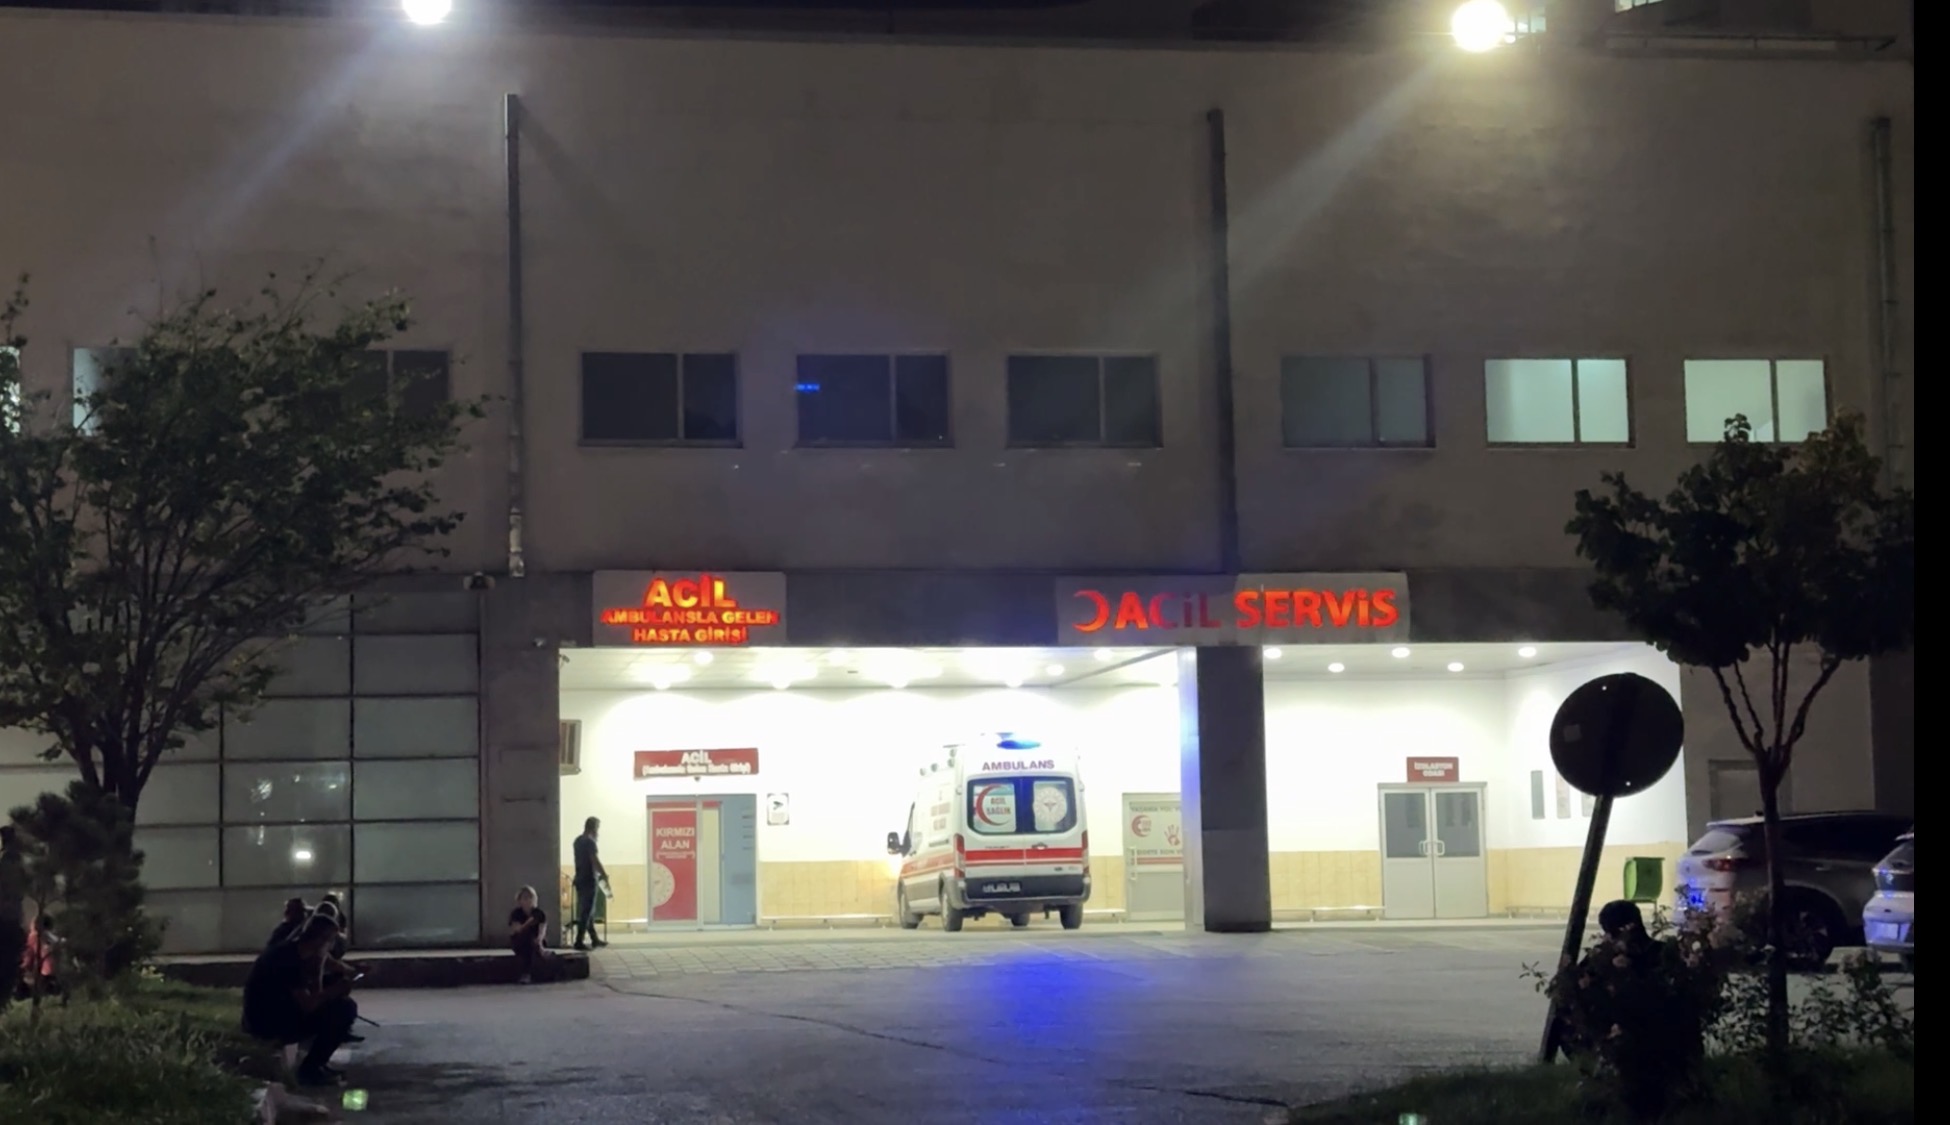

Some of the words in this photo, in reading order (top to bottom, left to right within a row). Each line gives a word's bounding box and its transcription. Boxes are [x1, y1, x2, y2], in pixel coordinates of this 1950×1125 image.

[644, 573, 737, 608] ACİL
[600, 609, 718, 625] AMBULANSLA
[721, 610, 779, 625] GELEN
[633, 628, 690, 642] HASTA
[982, 759, 1055, 771] AMBULANS
[656, 827, 695, 837] KIRMIZI
[661, 839, 690, 849] ALAN
